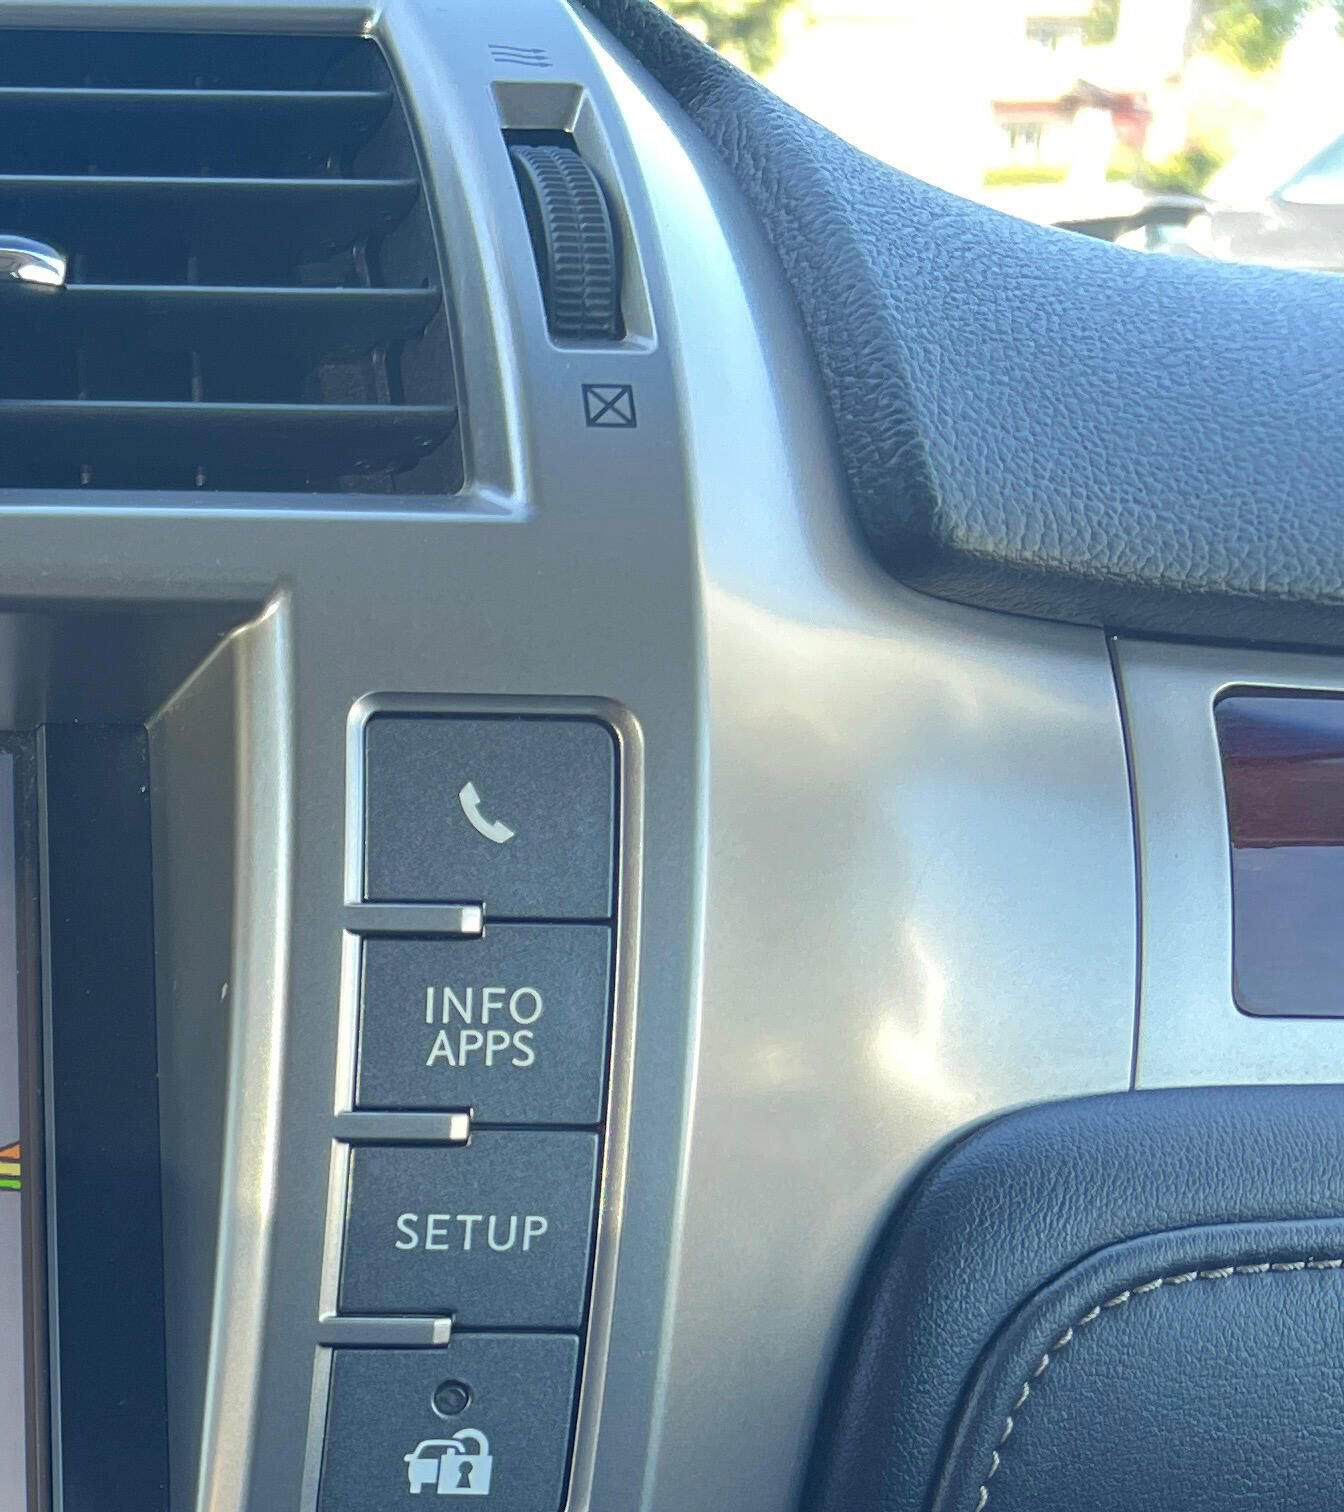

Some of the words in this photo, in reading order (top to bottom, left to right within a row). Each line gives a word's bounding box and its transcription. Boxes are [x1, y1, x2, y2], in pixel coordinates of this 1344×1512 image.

[425, 986, 543, 1025] INFO
[425, 1029, 535, 1067] APPS
[395, 1212, 548, 1251] SETUP
